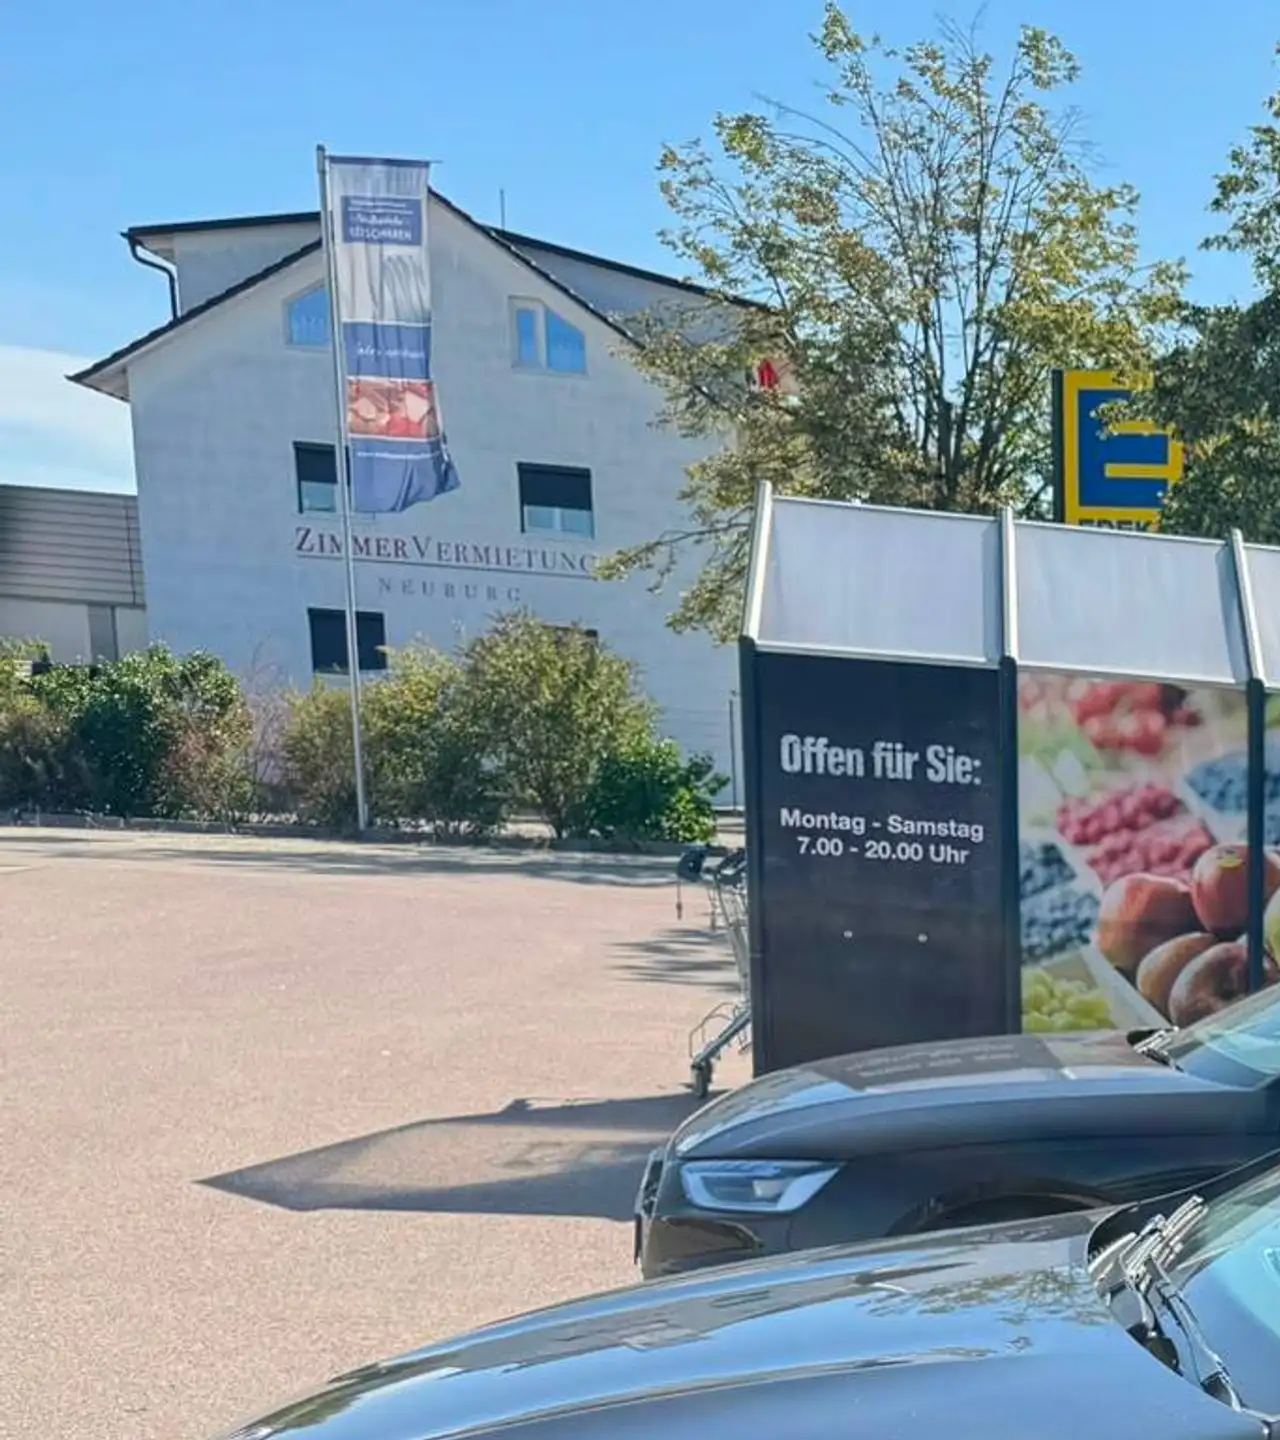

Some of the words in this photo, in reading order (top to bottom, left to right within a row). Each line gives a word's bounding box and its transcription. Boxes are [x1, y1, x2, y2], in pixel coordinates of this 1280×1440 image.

[377, 577, 522, 602] NEUBURG
[780, 734, 864, 777] Offen
[872, 741, 919, 780] für
[926, 745, 982, 785] Sie:
[780, 808, 866, 835] Montag
[887, 814, 984, 842] Samstag
[797, 836, 843, 856] 7.00
[865, 841, 923, 860] 20.00
[929, 844, 970, 864] Uhr
